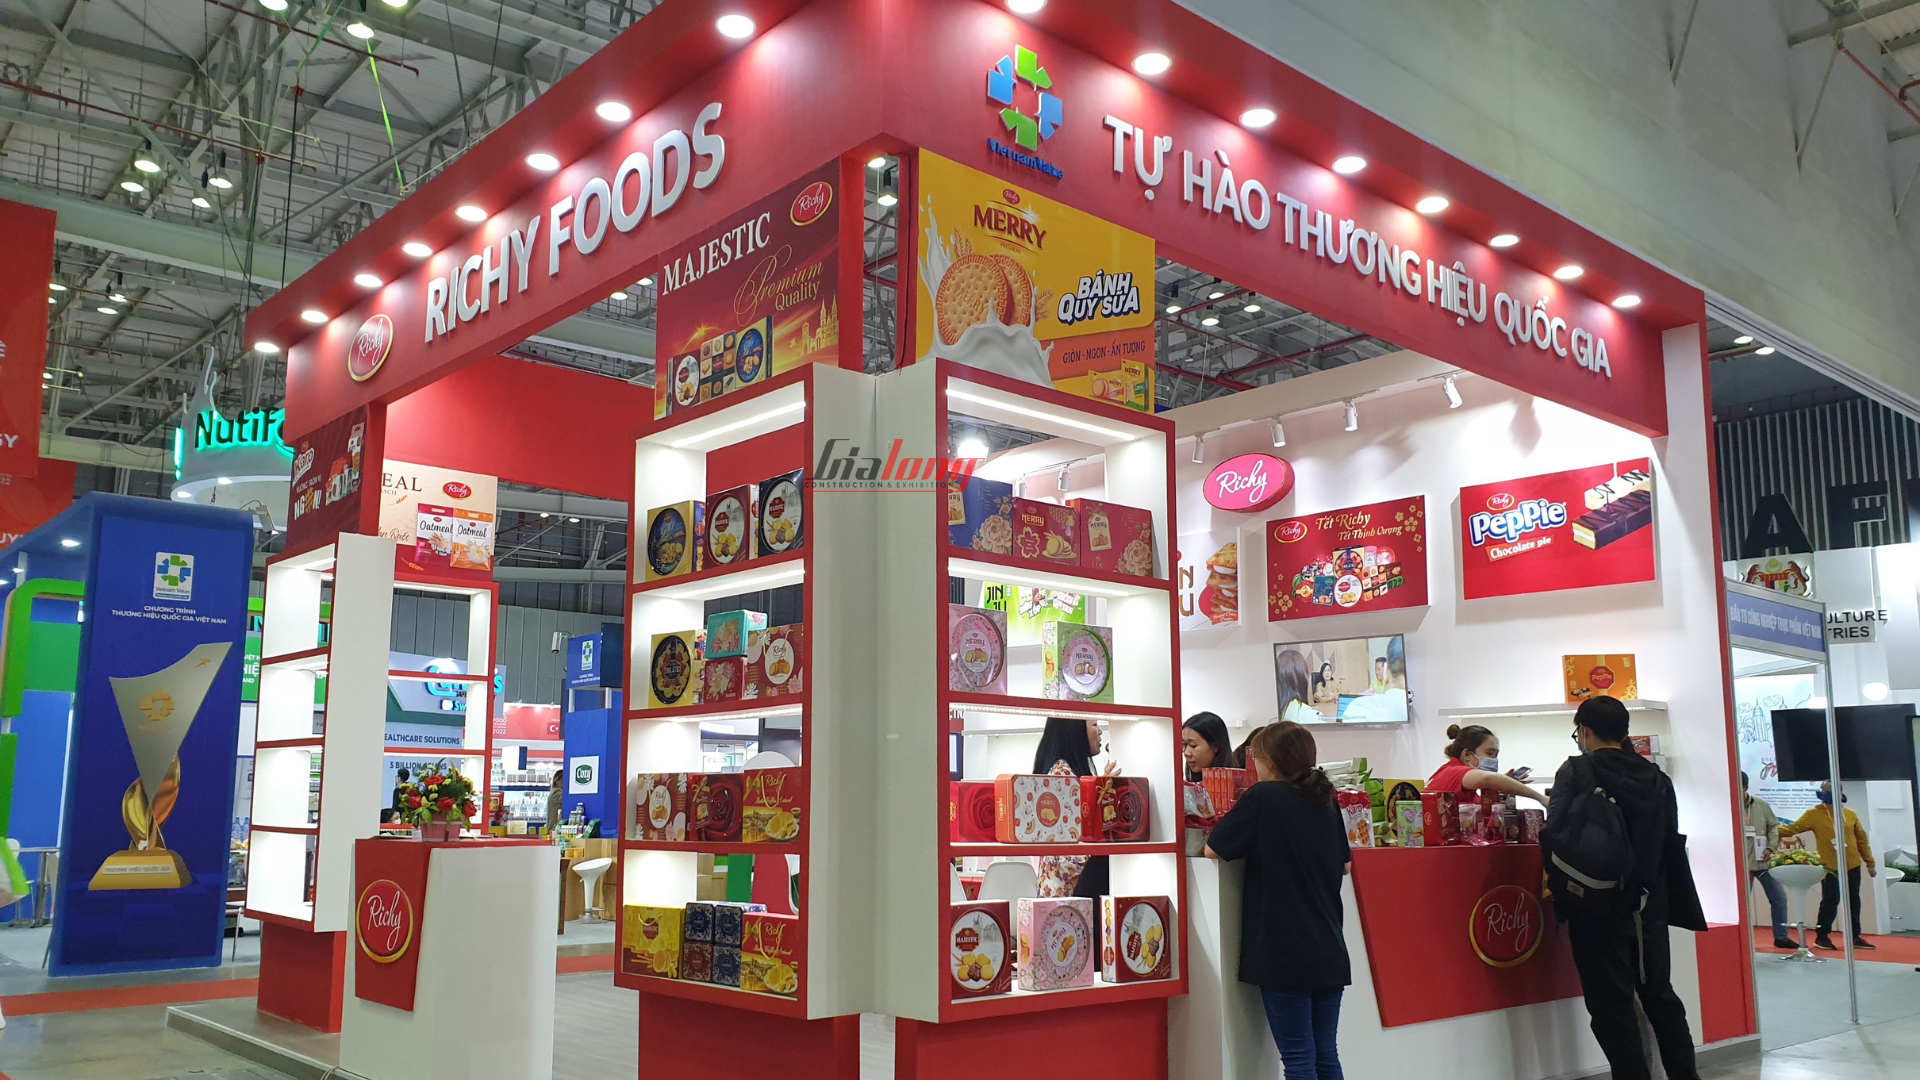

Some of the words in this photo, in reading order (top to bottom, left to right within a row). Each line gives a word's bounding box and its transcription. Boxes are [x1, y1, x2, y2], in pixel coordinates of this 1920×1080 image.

[798, 184, 826, 215] Richy
[424, 215, 540, 344] RICHY
[548, 101, 726, 277] FOODS
[973, 204, 1047, 250] MERRY
[662, 211, 771, 296] MAJESTIC
[1103, 113, 1173, 201] TỰ
[1182, 149, 1271, 230] HÀO
[1276, 192, 1422, 296] THƯƠNG
[1426, 259, 1487, 327] HIỆU
[1494, 295, 1568, 358] QUỐC
[1571, 327, 1612, 378] GIA
[734, 245, 824, 327] Premium
[775, 280, 820, 311] Quality
[1077, 269, 1133, 301] BÁNH
[1058, 293, 1101, 326] QUY
[1100, 286, 1141, 318] SỮA
[357, 317, 384, 367] Richy
[1062, 346, 1081, 365] GIÒN
[1086, 346, 1107, 361] NGON
[1122, 340, 1146, 357] TƯỢNG
[194, 406, 285, 449] Nutif
[447, 484, 468, 498] Richy
[1215, 459, 1268, 503] Richy
[1491, 493, 1509, 508] Richy
[420, 520, 453, 534] Oatmeal
[458, 524, 488, 538] Oatmeal
[1021, 513, 1045, 527] MERRY
[1090, 520, 1108, 530] MERRY
[1281, 522, 1301, 539] Richy
[1315, 515, 1334, 531] Tết
[1336, 511, 1371, 530] Richy
[1338, 530, 1350, 541] Tết
[1490, 540, 1535, 560] Chocolate
[1537, 535, 1551, 548] pie
[987, 585, 1004, 604] JIN
[112, 609, 142, 618] THƯƠNG
[211, 617, 227, 625] NAM
[175, 607, 196, 615] TRÌNH
[965, 638, 986, 647] MERRY
[1075, 652, 1094, 661] MERRY
[424, 736, 460, 745] SOLUTIONS
[576, 767, 591, 780] Cozy
[367, 890, 402, 951] Richy
[1483, 892, 1530, 952] Richy
[956, 936, 978, 944] MAJESTIC
[1050, 926, 1067, 950] MERRY
[1129, 933, 1140, 960] MAJESTIC
